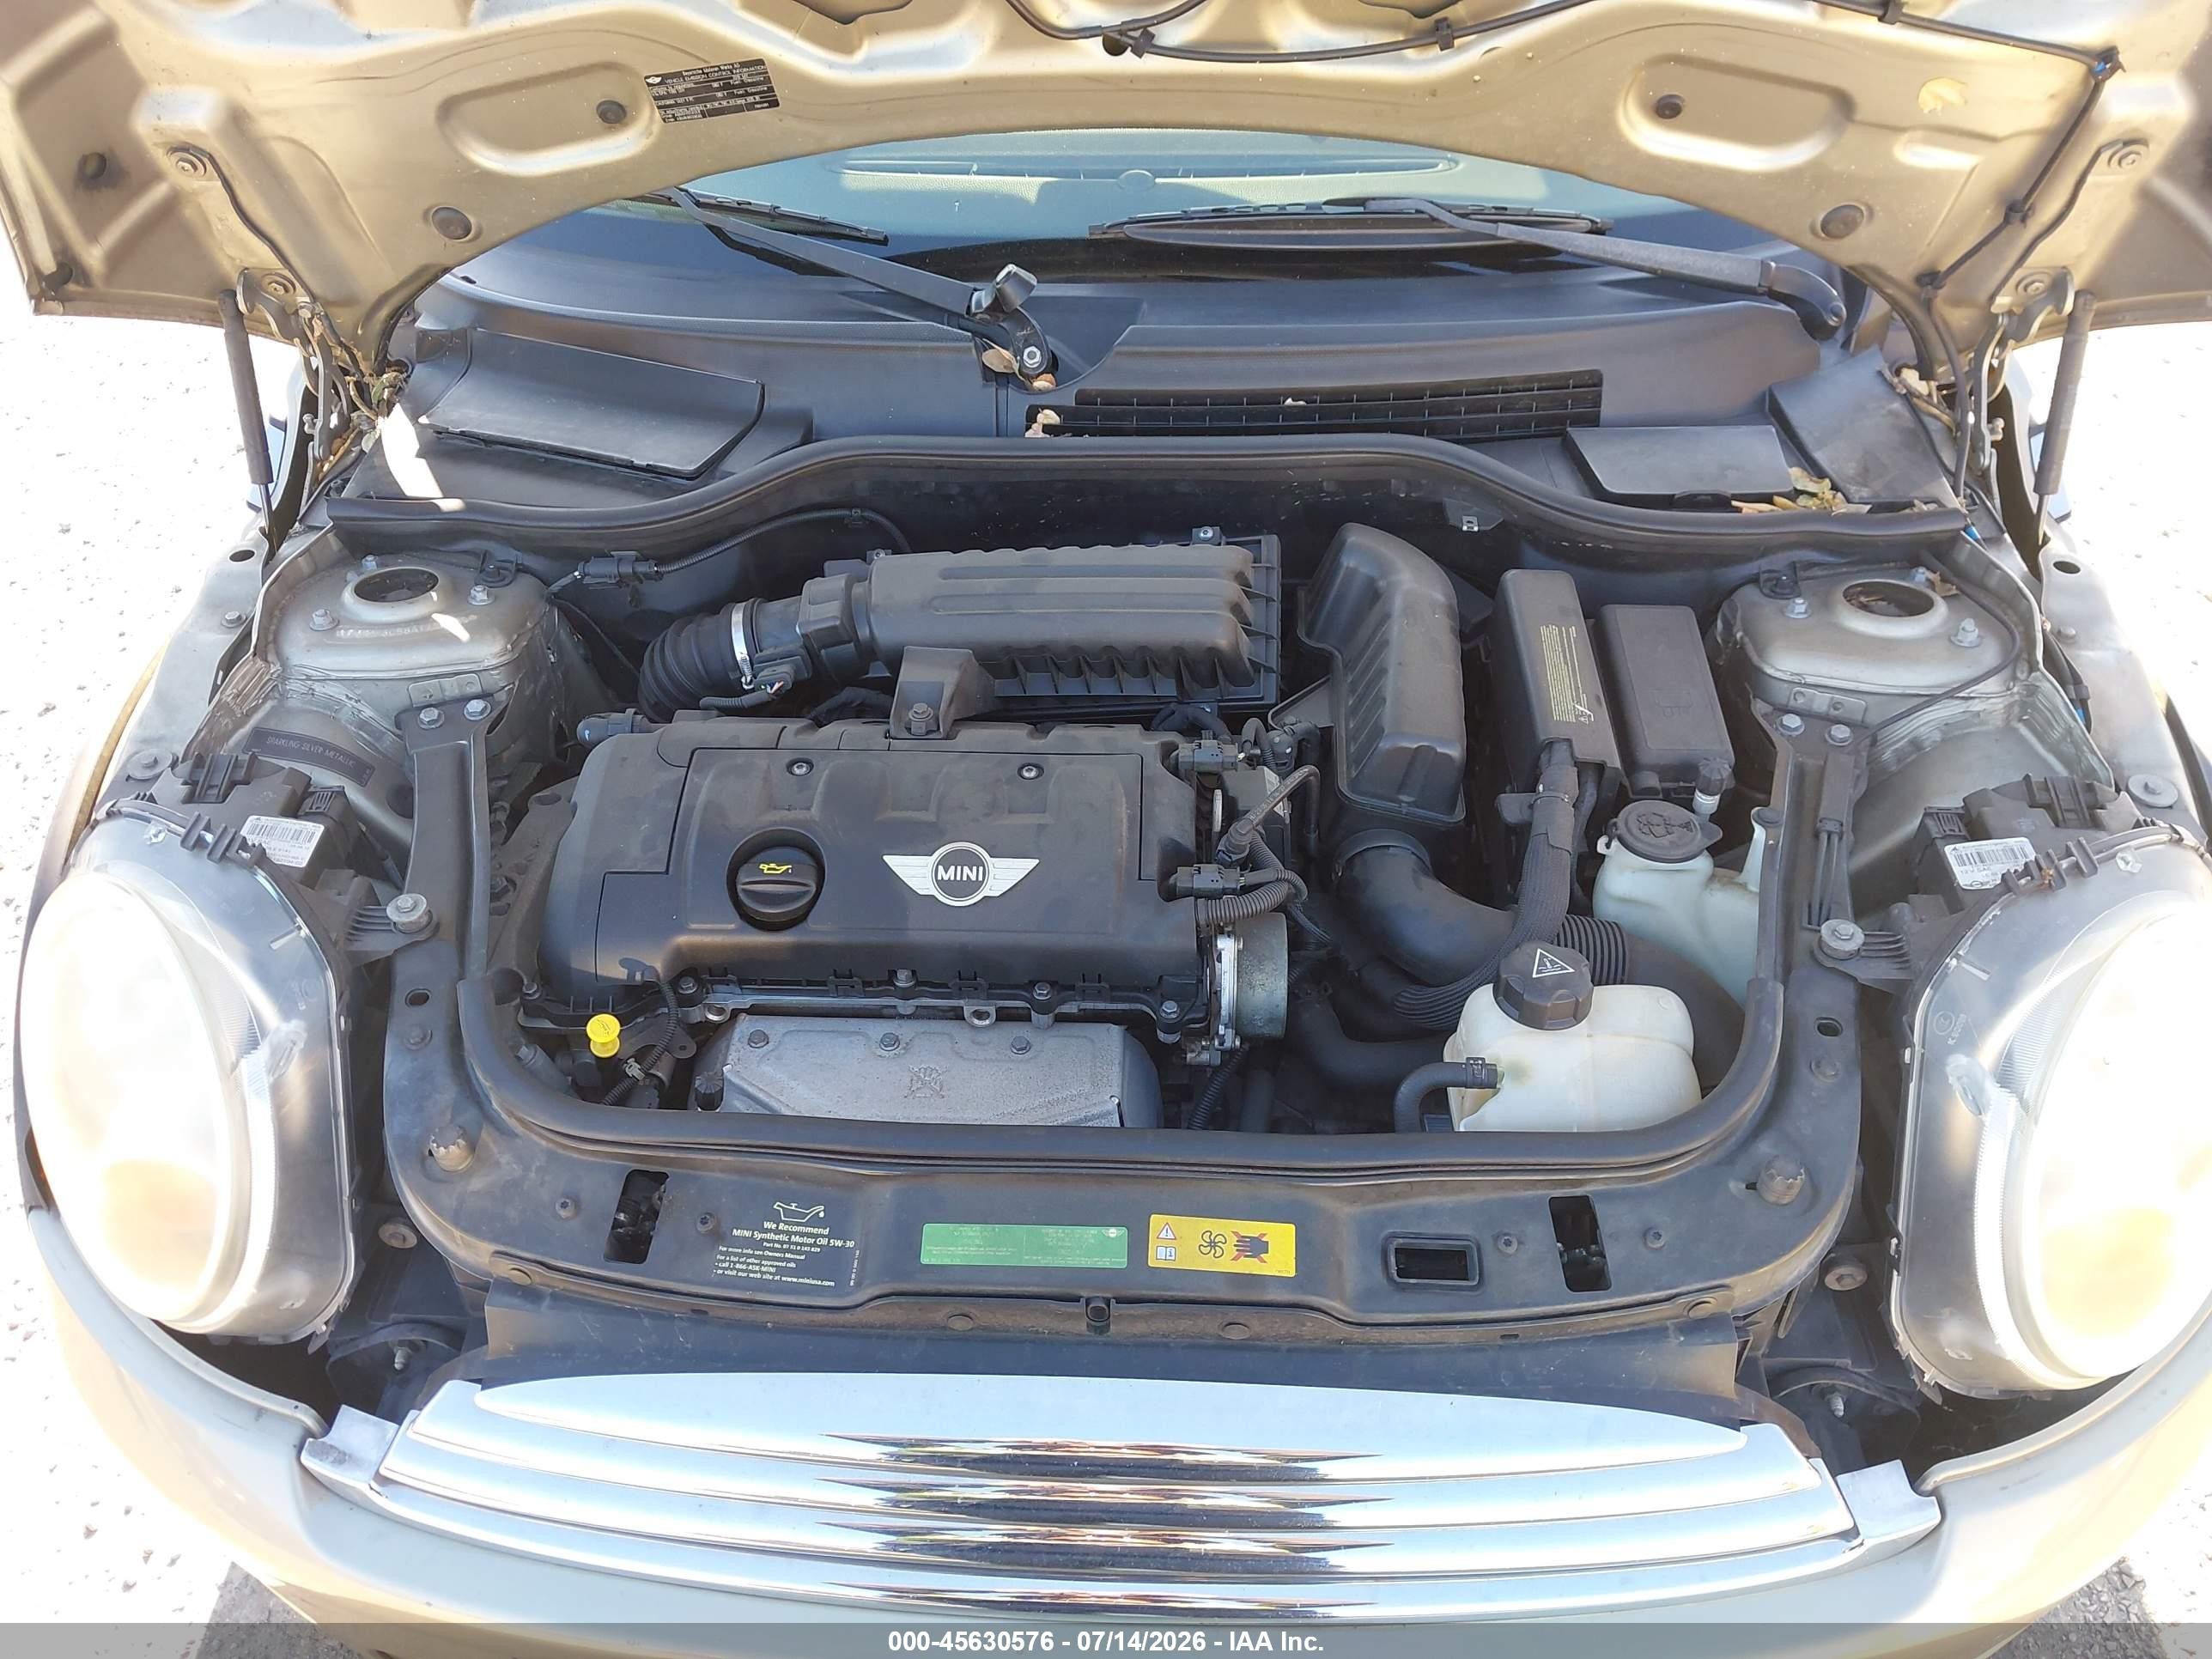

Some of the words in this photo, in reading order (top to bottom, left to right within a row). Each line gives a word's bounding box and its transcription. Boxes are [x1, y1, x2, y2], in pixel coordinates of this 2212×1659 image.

[733, 64, 767, 74] INFORMATION
[937, 865, 983, 881] MINI
[763, 1221, 777, 1230] We
[778, 1223, 830, 1235] Recommend
[732, 1229, 752, 1237] MINI
[753, 1231, 789, 1241] Synthetic
[790, 1235, 815, 1244] Motor
[830, 1238, 855, 1248] 5W-30
[730, 1262, 776, 1273] 1-866-ASK-MINI
[781, 1276, 836, 1286] www.miniusa.com
